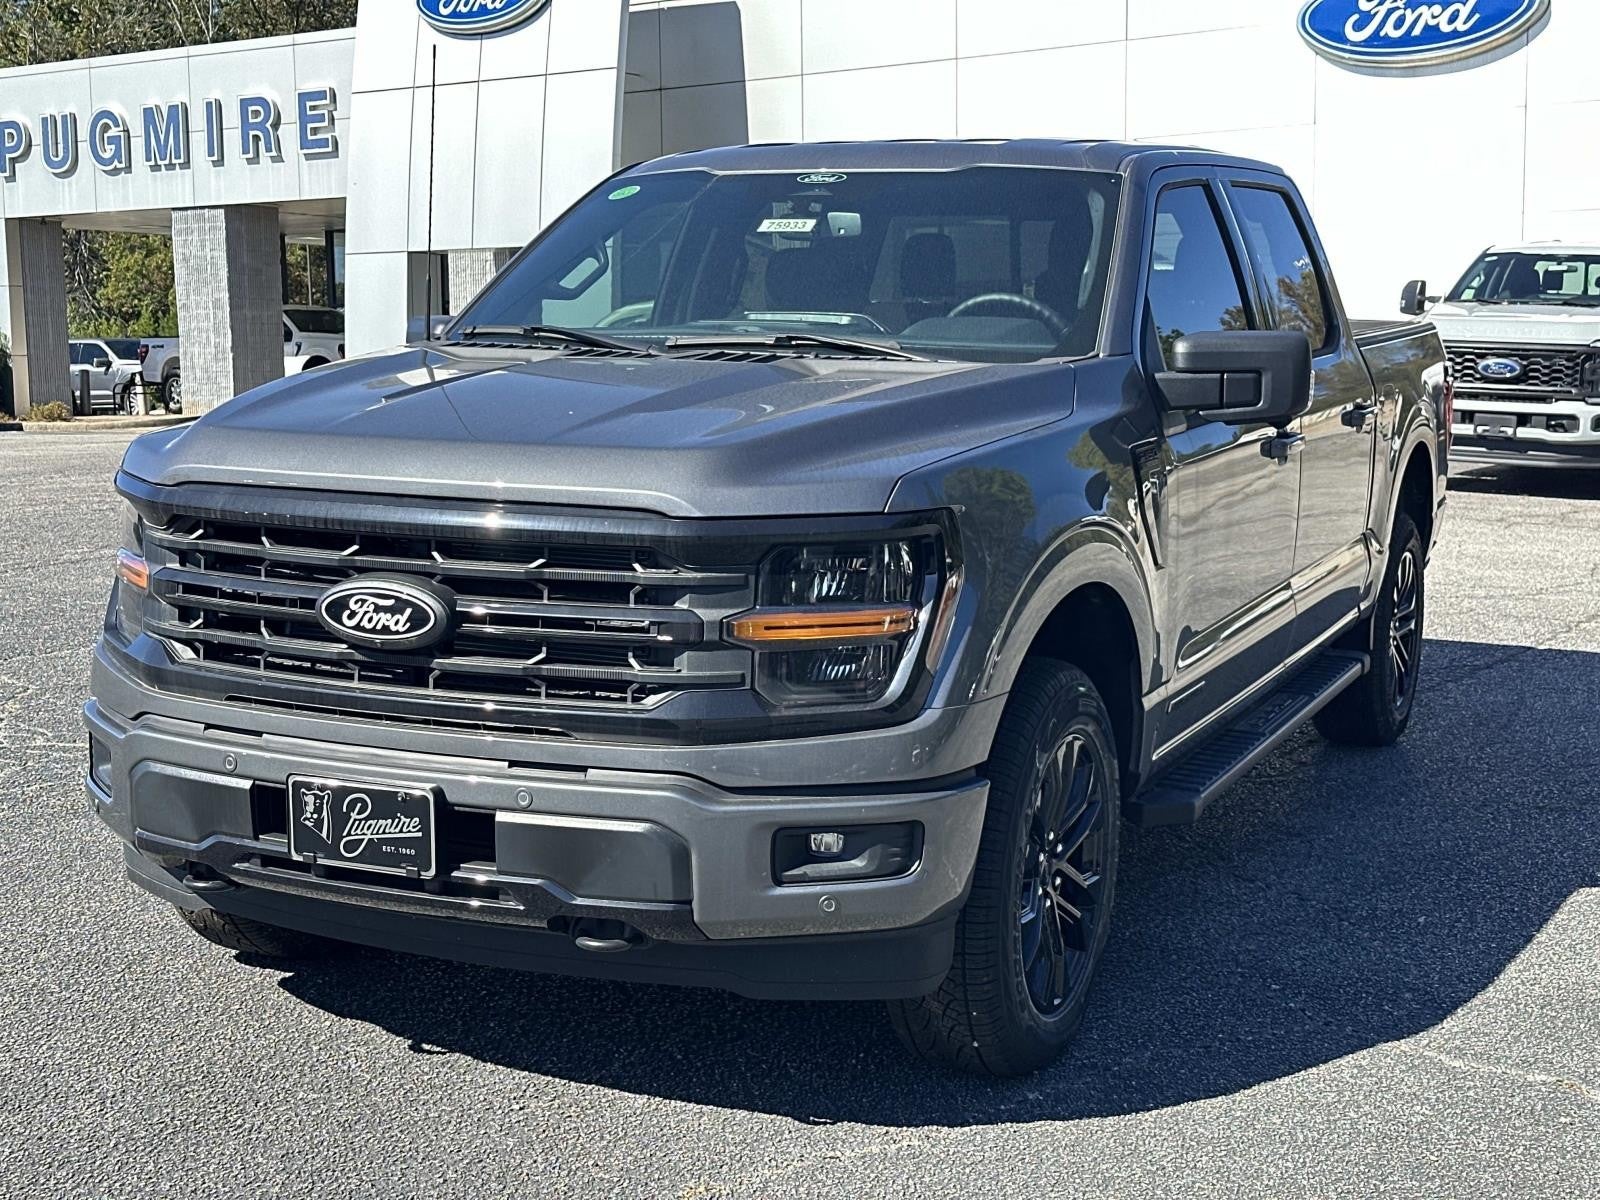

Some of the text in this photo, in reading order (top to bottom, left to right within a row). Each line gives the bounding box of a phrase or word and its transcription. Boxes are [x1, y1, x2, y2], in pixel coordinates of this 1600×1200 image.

[1345, 0, 1480, 42] Ford
[0, 87, 337, 180] PUGMIRE
[766, 221, 808, 230] 75933
[342, 594, 413, 633] Ford
[340, 793, 423, 858] Pugmire
[382, 845, 416, 856] EST. 1960
